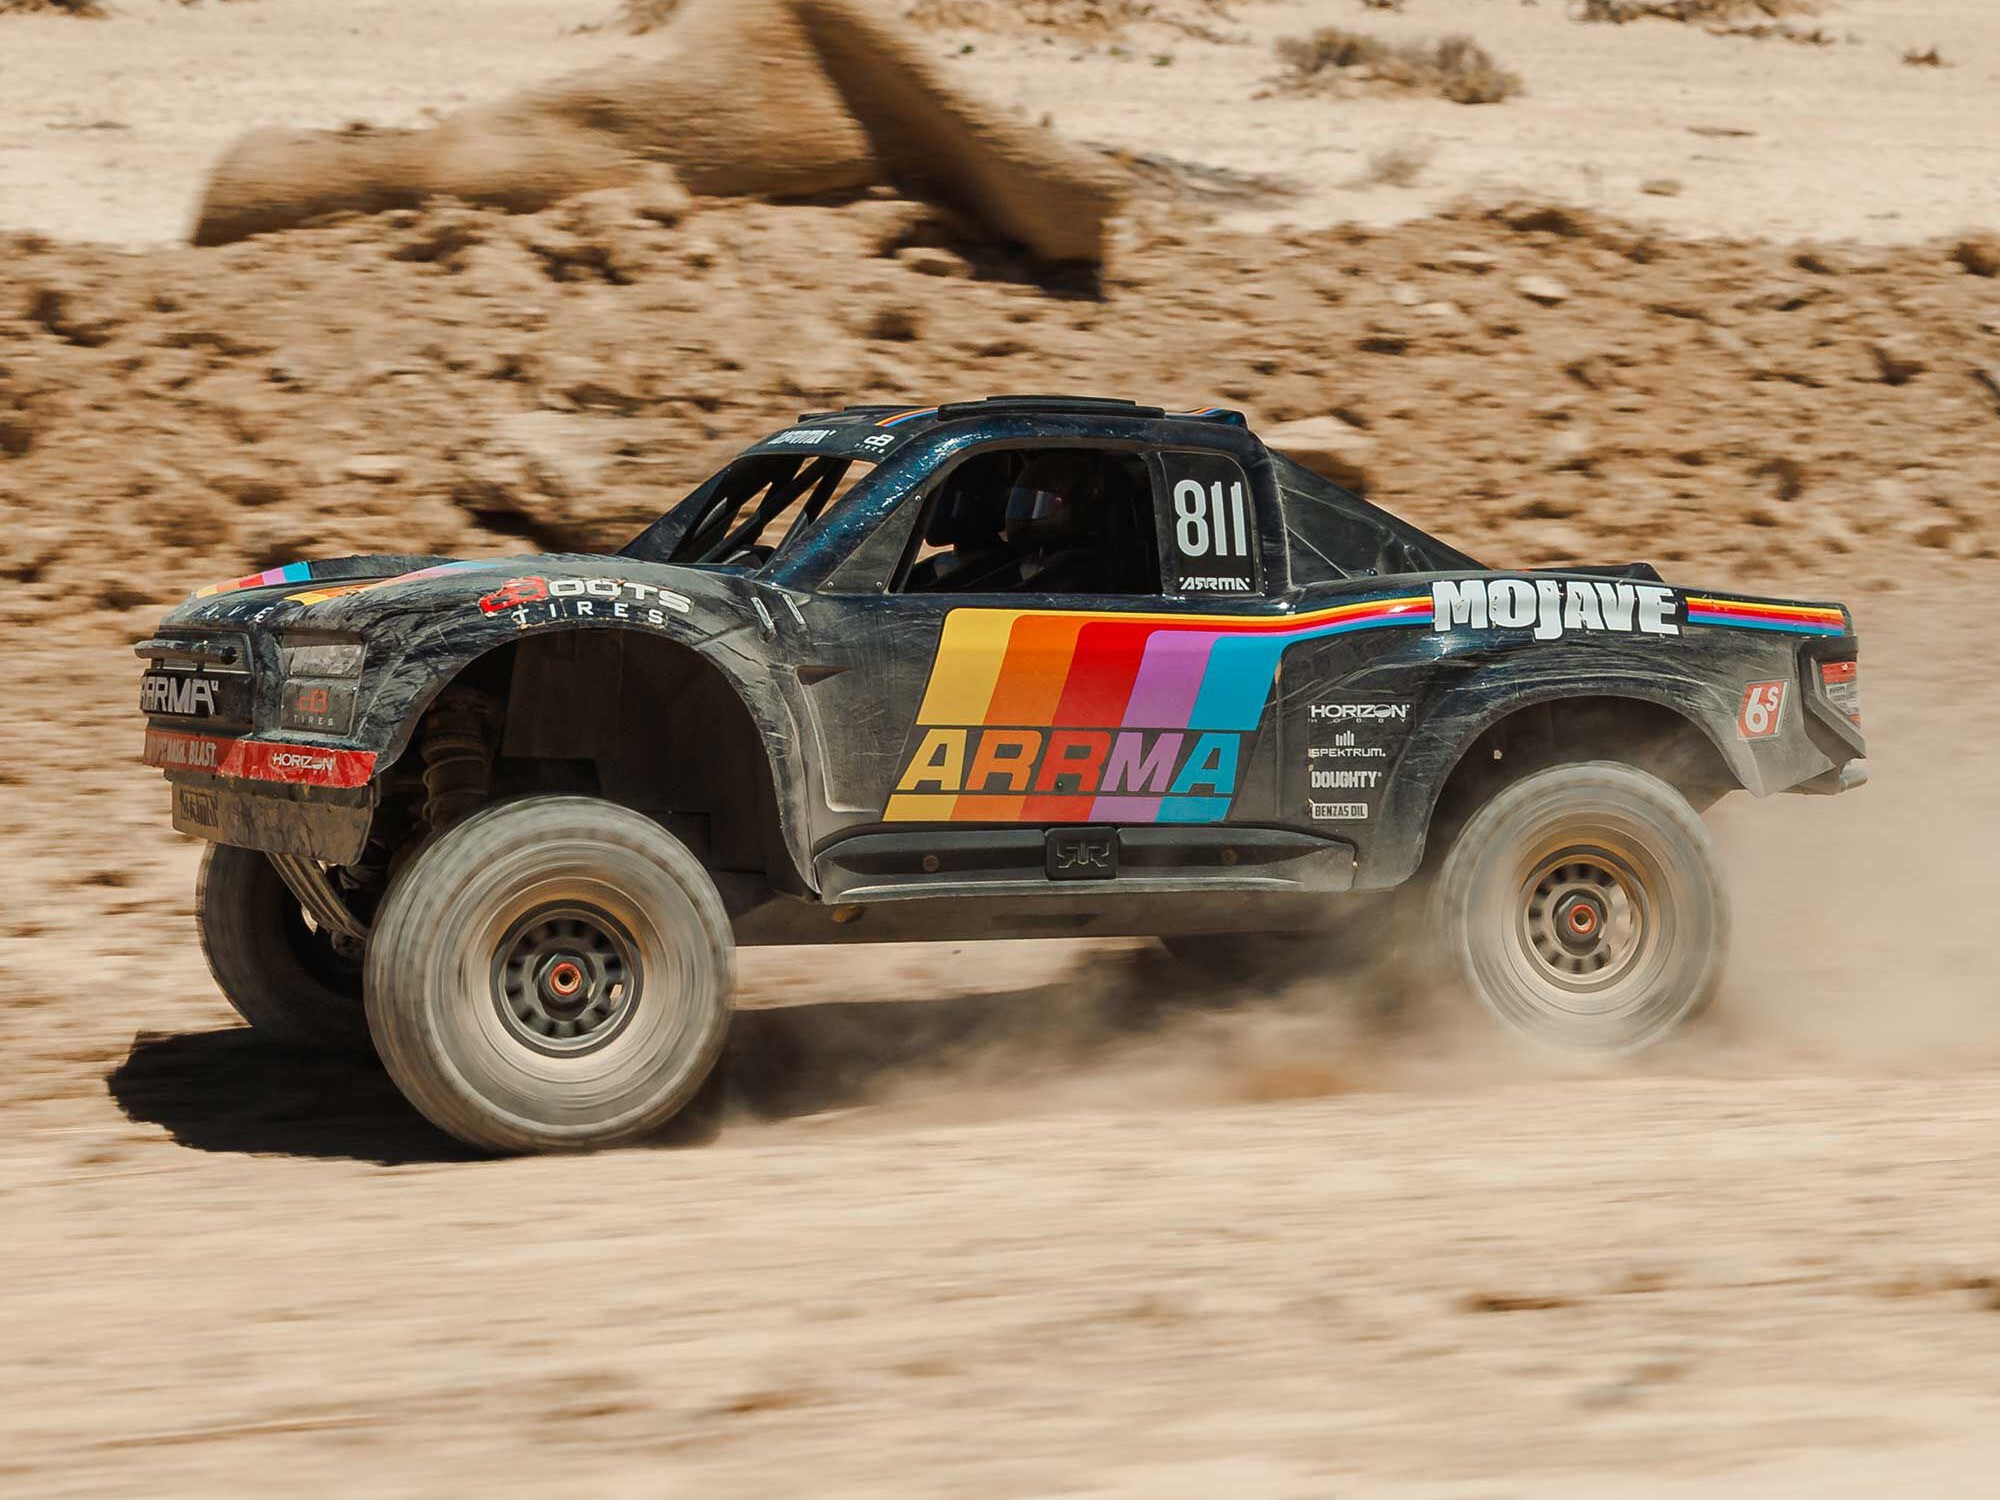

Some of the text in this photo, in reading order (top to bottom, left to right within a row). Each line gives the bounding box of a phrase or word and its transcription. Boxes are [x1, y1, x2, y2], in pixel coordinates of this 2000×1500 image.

[1173, 479, 1247, 557] 811
[512, 600, 664, 627] TIRES
[1432, 579, 1680, 641] MOJAVE
[293, 714, 334, 727] TIRES
[1310, 703, 1406, 718] HORIZON
[894, 728, 1242, 795] ARRMA
[1311, 770, 1378, 789] DOUGHTY
[1350, 805, 1366, 817] OIL
